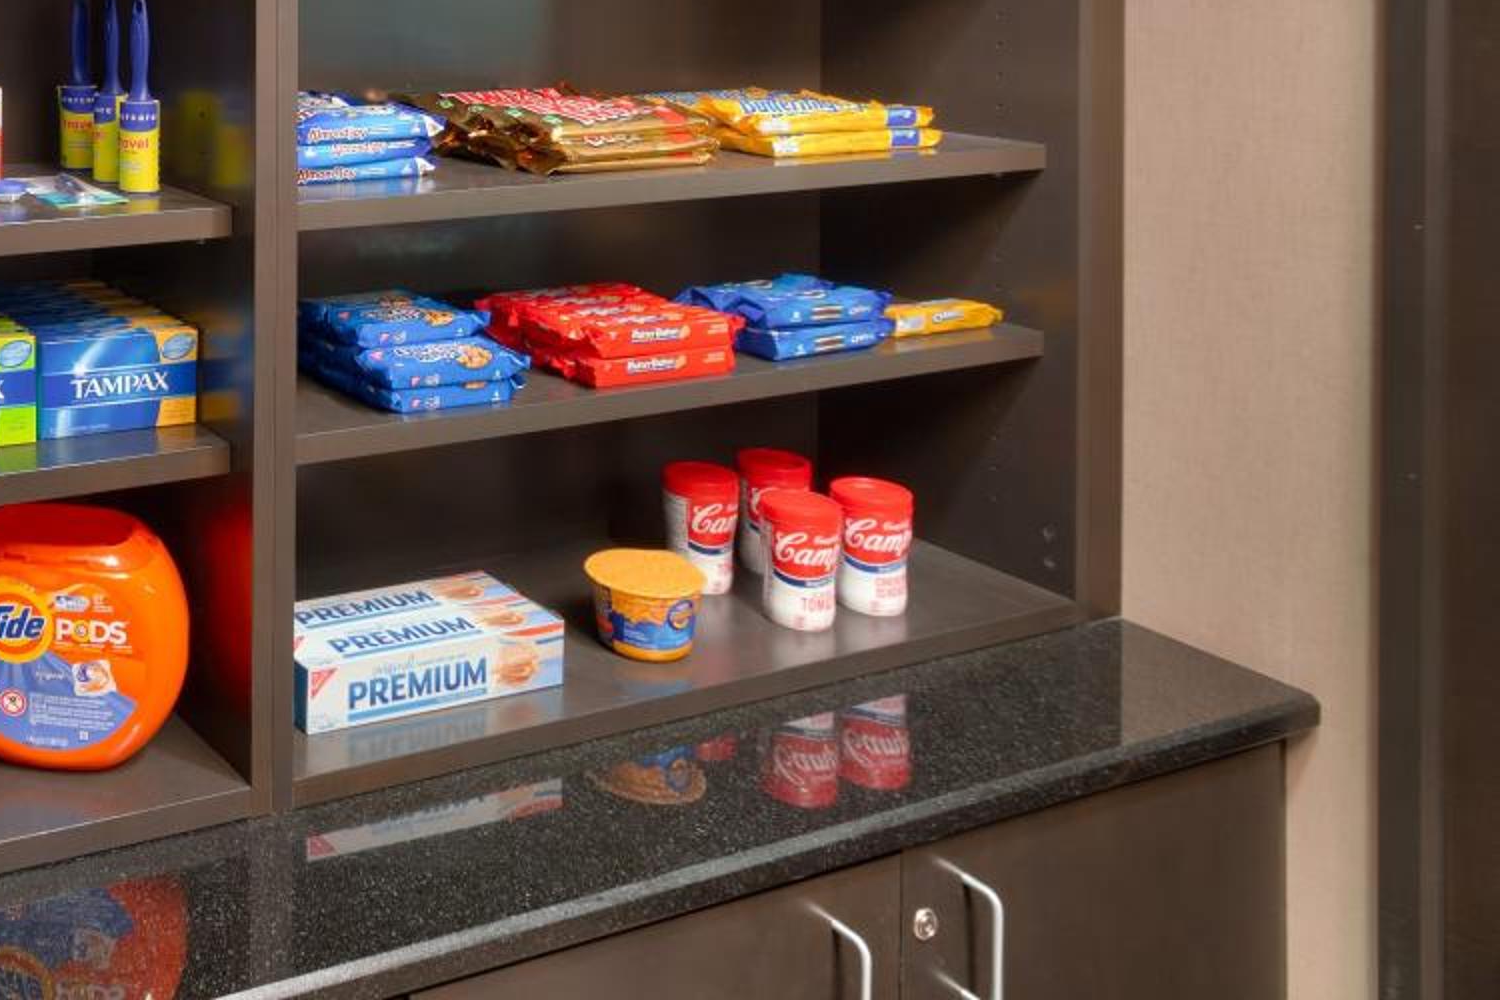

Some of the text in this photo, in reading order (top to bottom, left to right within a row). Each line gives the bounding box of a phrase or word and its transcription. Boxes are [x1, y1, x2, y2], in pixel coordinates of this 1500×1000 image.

[71, 371, 169, 399] TAMPAX
[295, 589, 435, 626] PREMIUM
[55, 617, 129, 644] PODS
[328, 615, 477, 654] PREMIUM
[347, 656, 487, 710] PREMIUM
